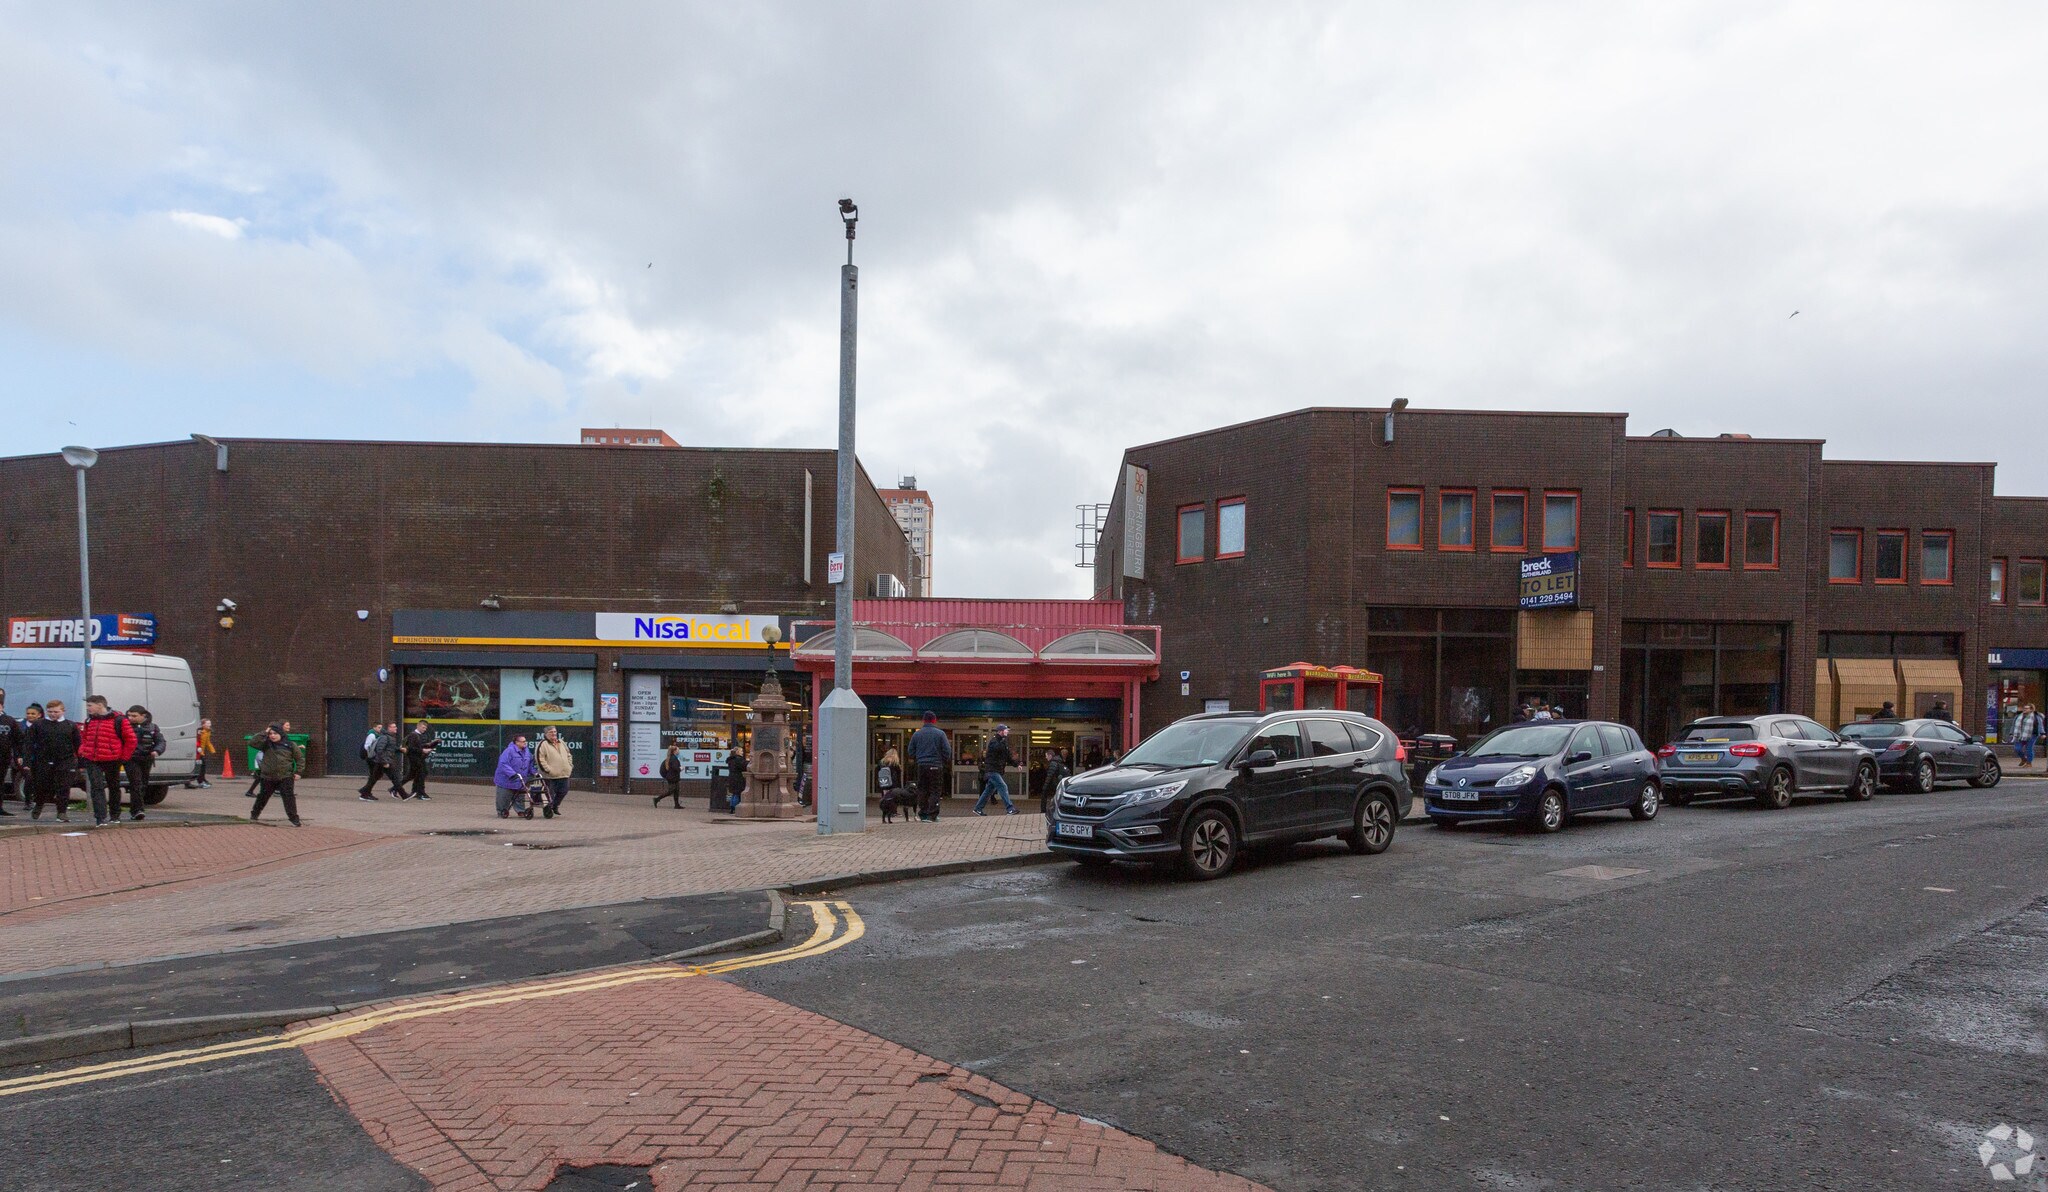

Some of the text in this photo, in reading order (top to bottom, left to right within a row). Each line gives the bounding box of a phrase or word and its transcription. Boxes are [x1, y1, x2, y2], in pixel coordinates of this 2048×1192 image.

[1126, 509, 1136, 555] CENTRE
[1134, 495, 1144, 574] SPRINGBURN
[830, 562, 843, 571] CCTV
[1521, 557, 1552, 573] breck
[1521, 569, 1552, 578] SUTHERLAND
[1522, 575, 1574, 594] TO LET
[1520, 592, 1573, 605] 0141 229 5494
[122, 617, 153, 626] BETFRED
[11, 618, 102, 644] BETFRED
[434, 731, 468, 739] LOCAL
[1444, 791, 1476, 799] ST08 JFK
[1061, 824, 1090, 835] BC16 GPY
